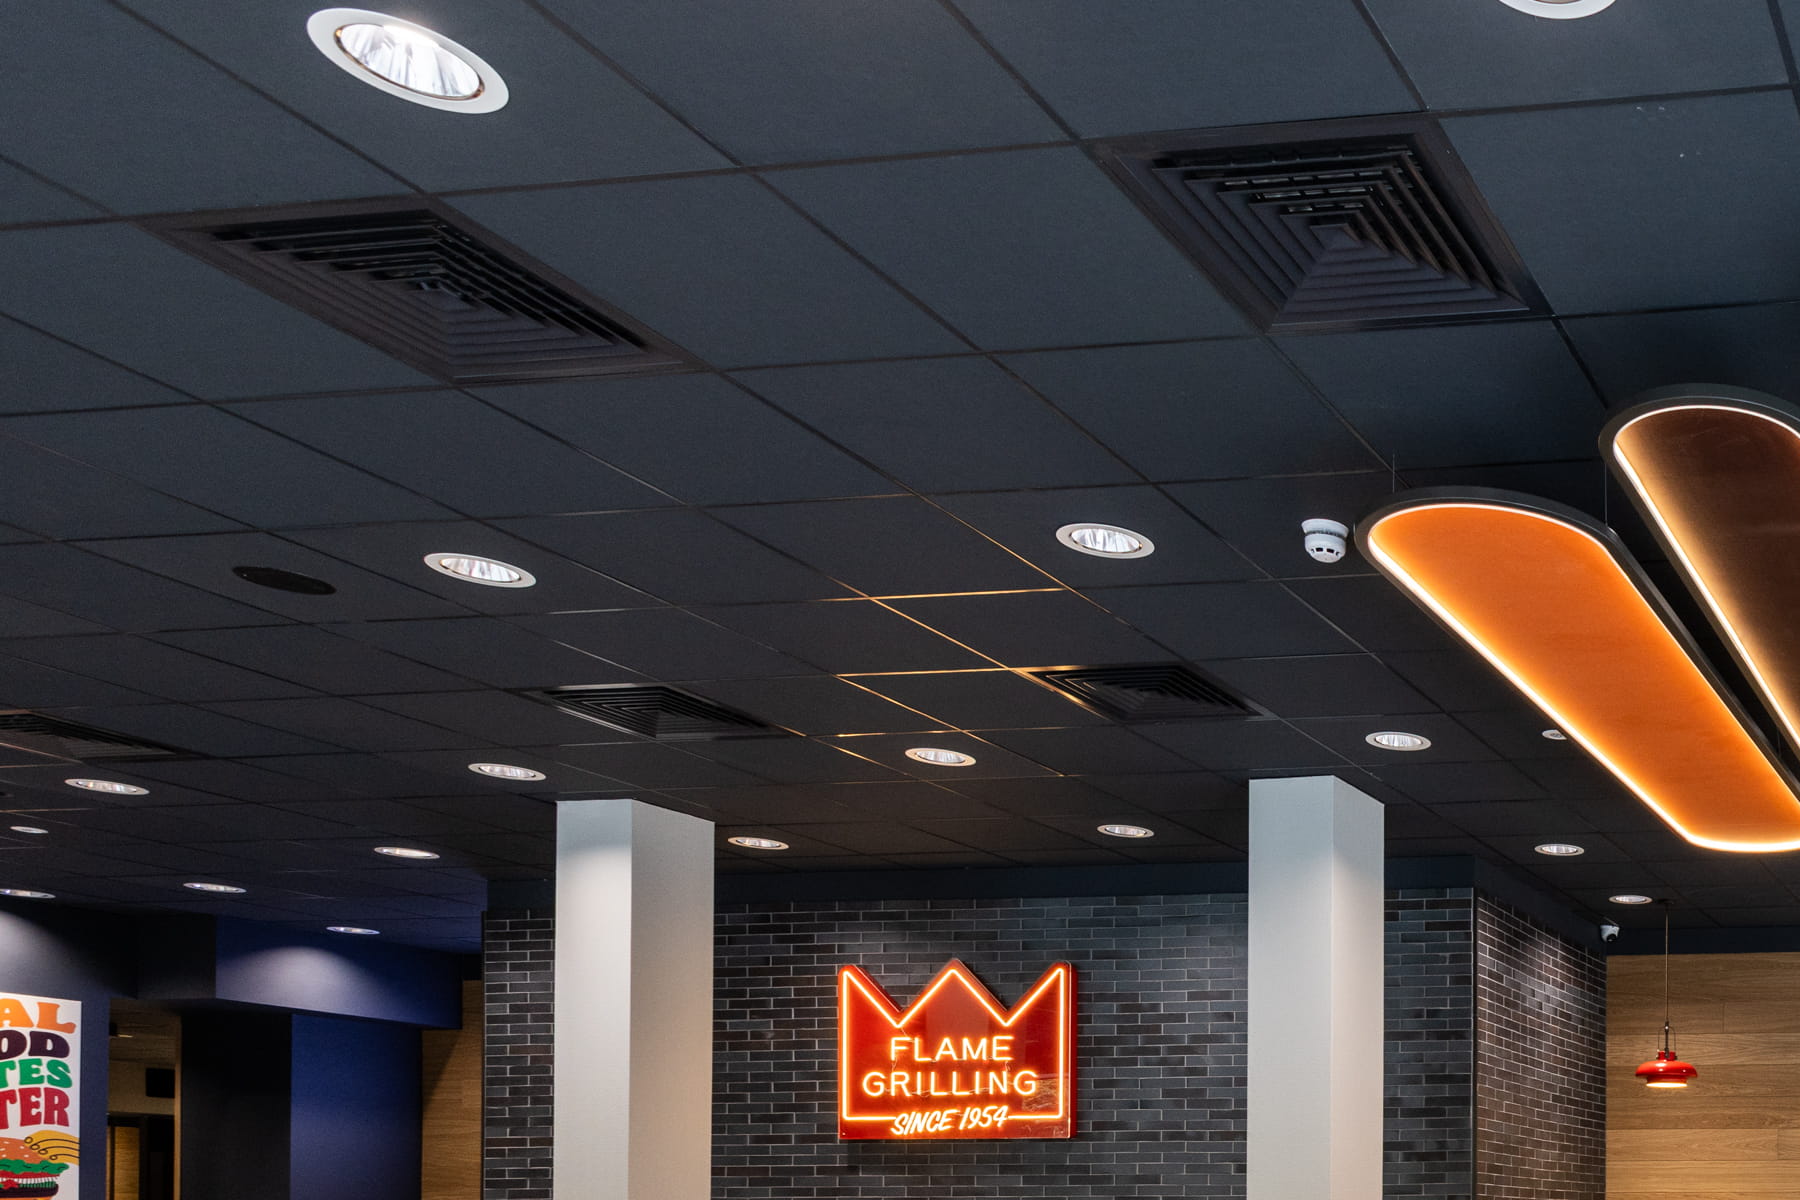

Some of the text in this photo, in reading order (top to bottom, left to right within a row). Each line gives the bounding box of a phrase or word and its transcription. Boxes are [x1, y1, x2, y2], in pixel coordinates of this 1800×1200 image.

[891, 1036, 1014, 1061] FLAME
[862, 1071, 1037, 1096] GRILLING
[891, 1105, 1008, 1135] SINCE 1954
